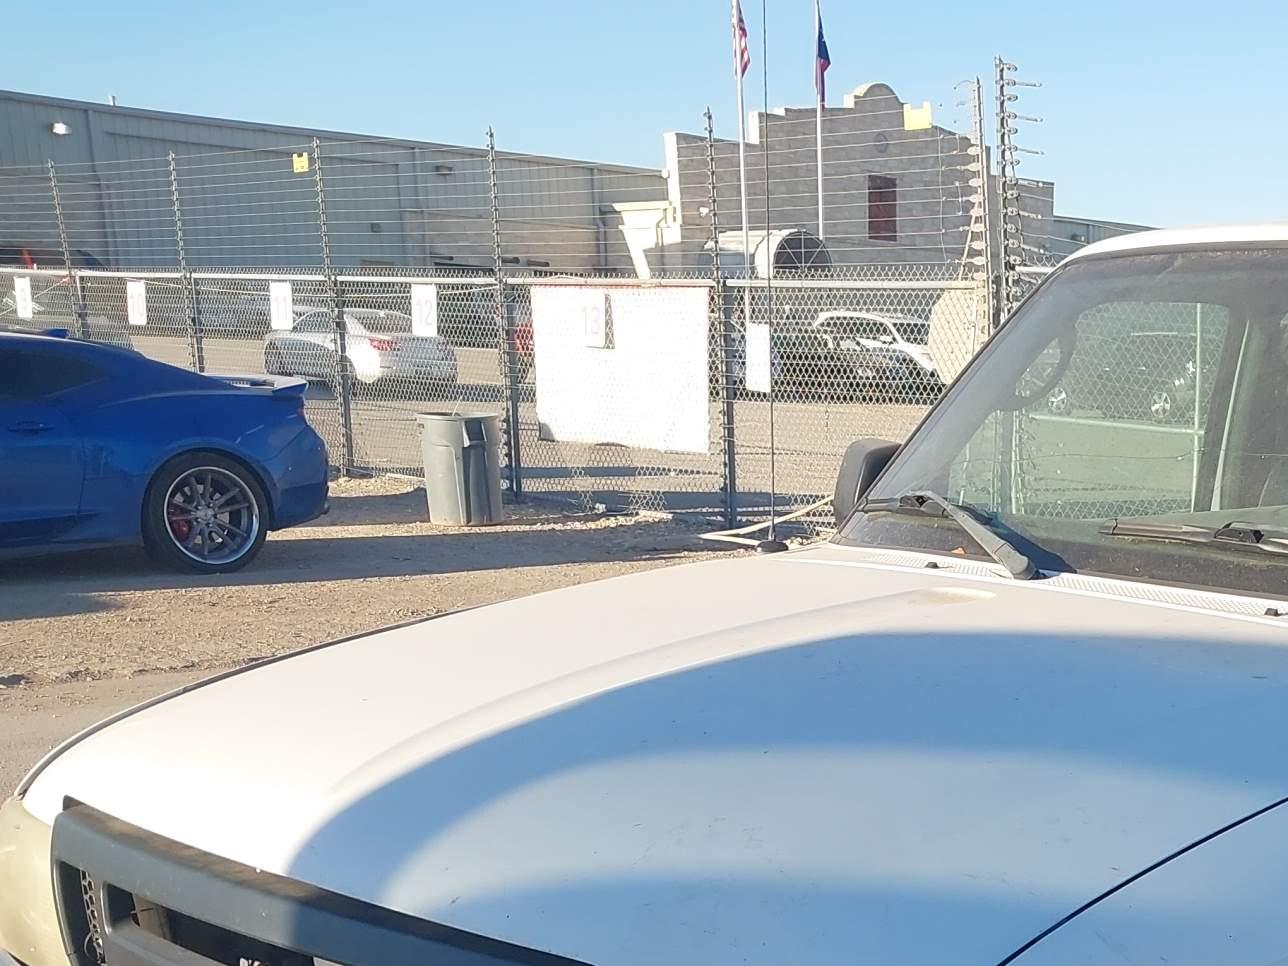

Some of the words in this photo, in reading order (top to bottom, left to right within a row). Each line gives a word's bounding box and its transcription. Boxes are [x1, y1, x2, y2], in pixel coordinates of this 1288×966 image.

[273, 295, 289, 321] 11
[415, 299, 433, 326] 12
[580, 304, 600, 335] 13
